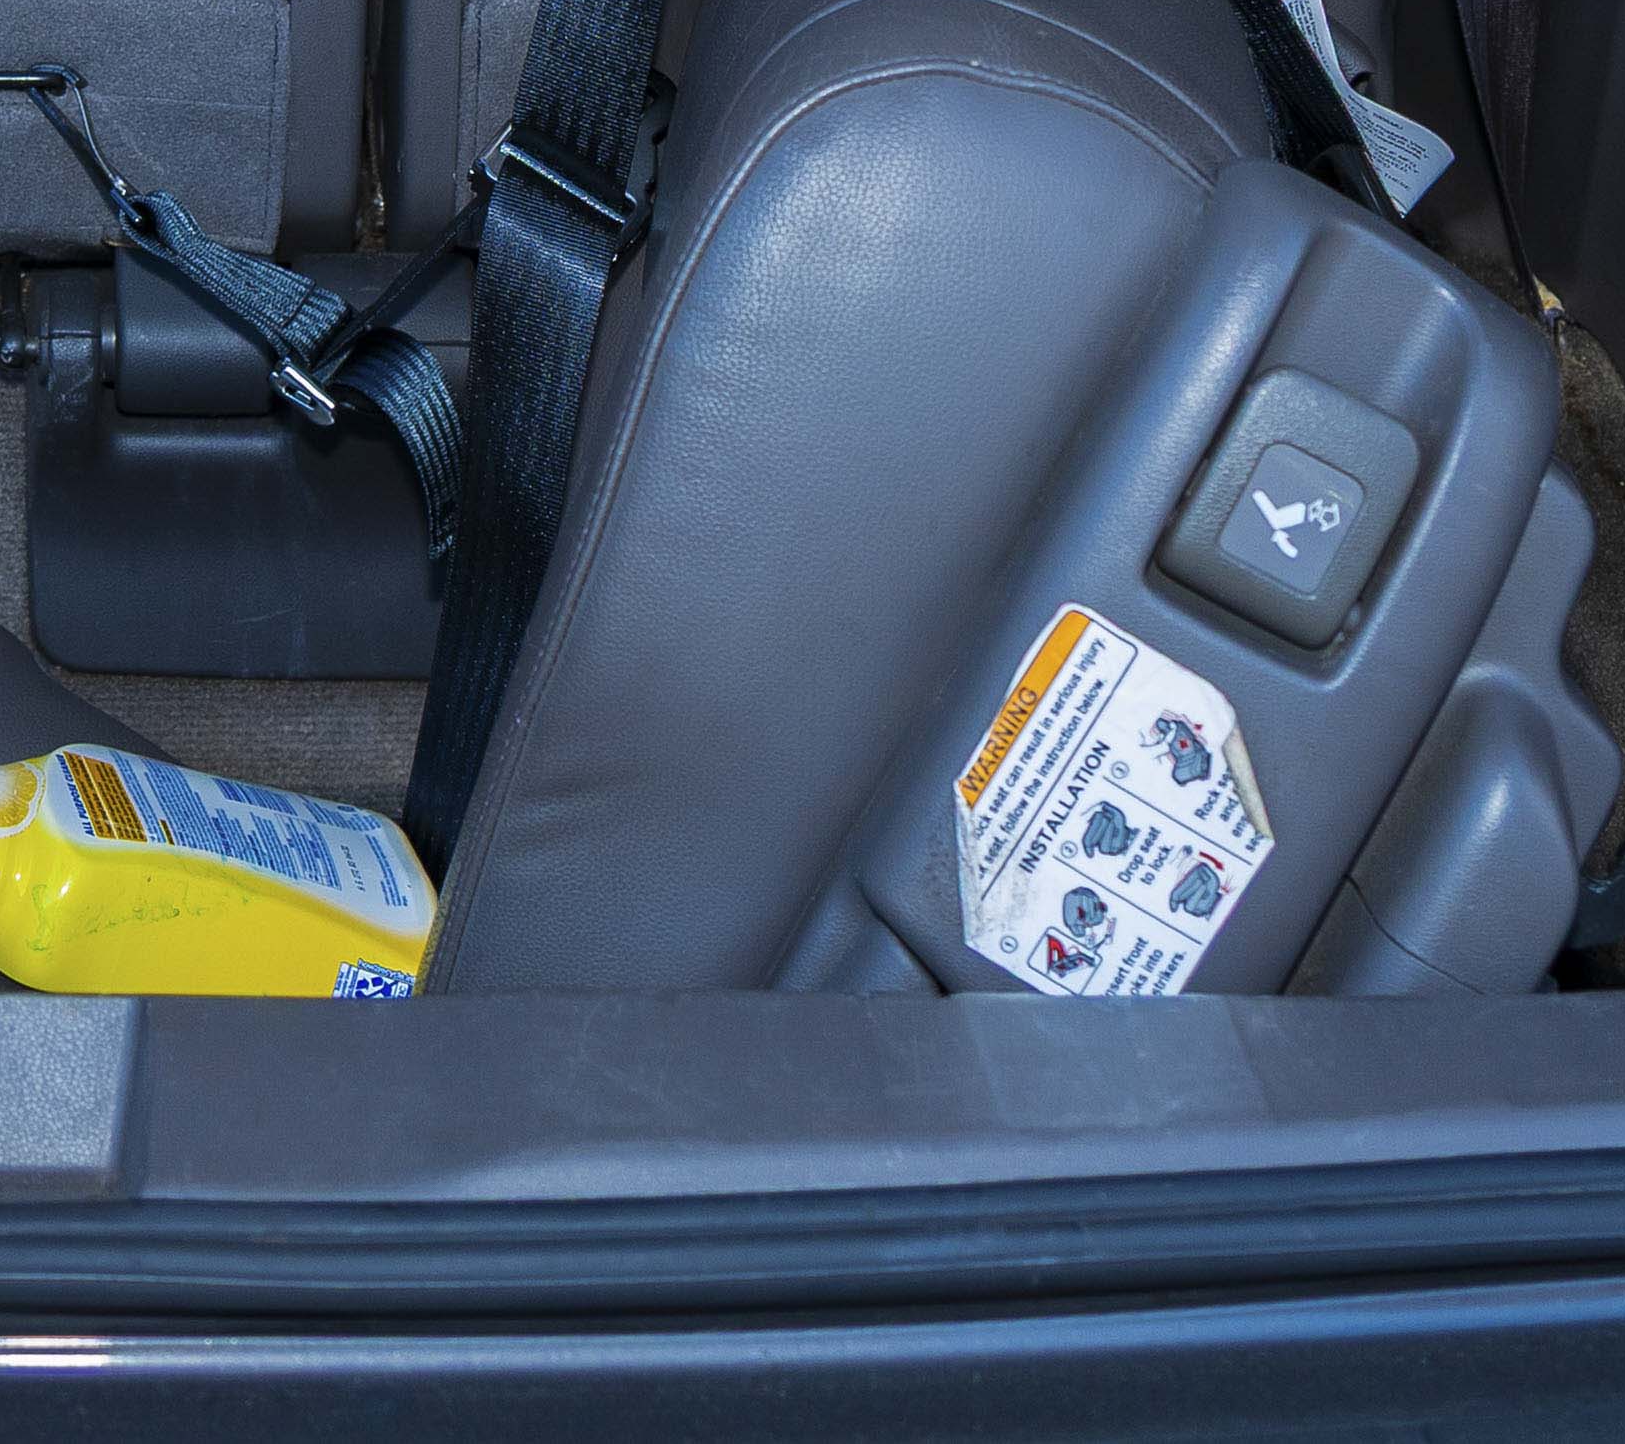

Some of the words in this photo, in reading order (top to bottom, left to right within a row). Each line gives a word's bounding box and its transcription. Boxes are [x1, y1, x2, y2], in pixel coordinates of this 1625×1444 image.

[961, 685, 1039, 794] WARNING
[970, 815, 993, 841] ock
[988, 786, 1010, 814] seat
[1005, 765, 1024, 788] can
[1019, 728, 1046, 765] result
[1038, 717, 1054, 731] in
[1049, 673, 1082, 717] serious
[1074, 637, 1107, 673] injury.
[999, 798, 1029, 835] follow
[1022, 778, 1043, 798] the
[1035, 715, 1083, 778] instruction
[1074, 678, 1105, 715] below.
[67, 783, 89, 819] PURPOSE
[1018, 739, 1111, 874] INSTALLATION
[1193, 790, 1221, 821] Rock
[1219, 796, 1240, 823] and
[81, 821, 95, 836] ALL
[1116, 853, 1146, 884] Drop
[1139, 826, 1161, 854] seat
[1147, 845, 1175, 872] lock.
[1139, 871, 1156, 886] to
[1104, 966, 1130, 1000] nsert
[1121, 936, 1149, 968] front
[1140, 948, 1164, 974] into
